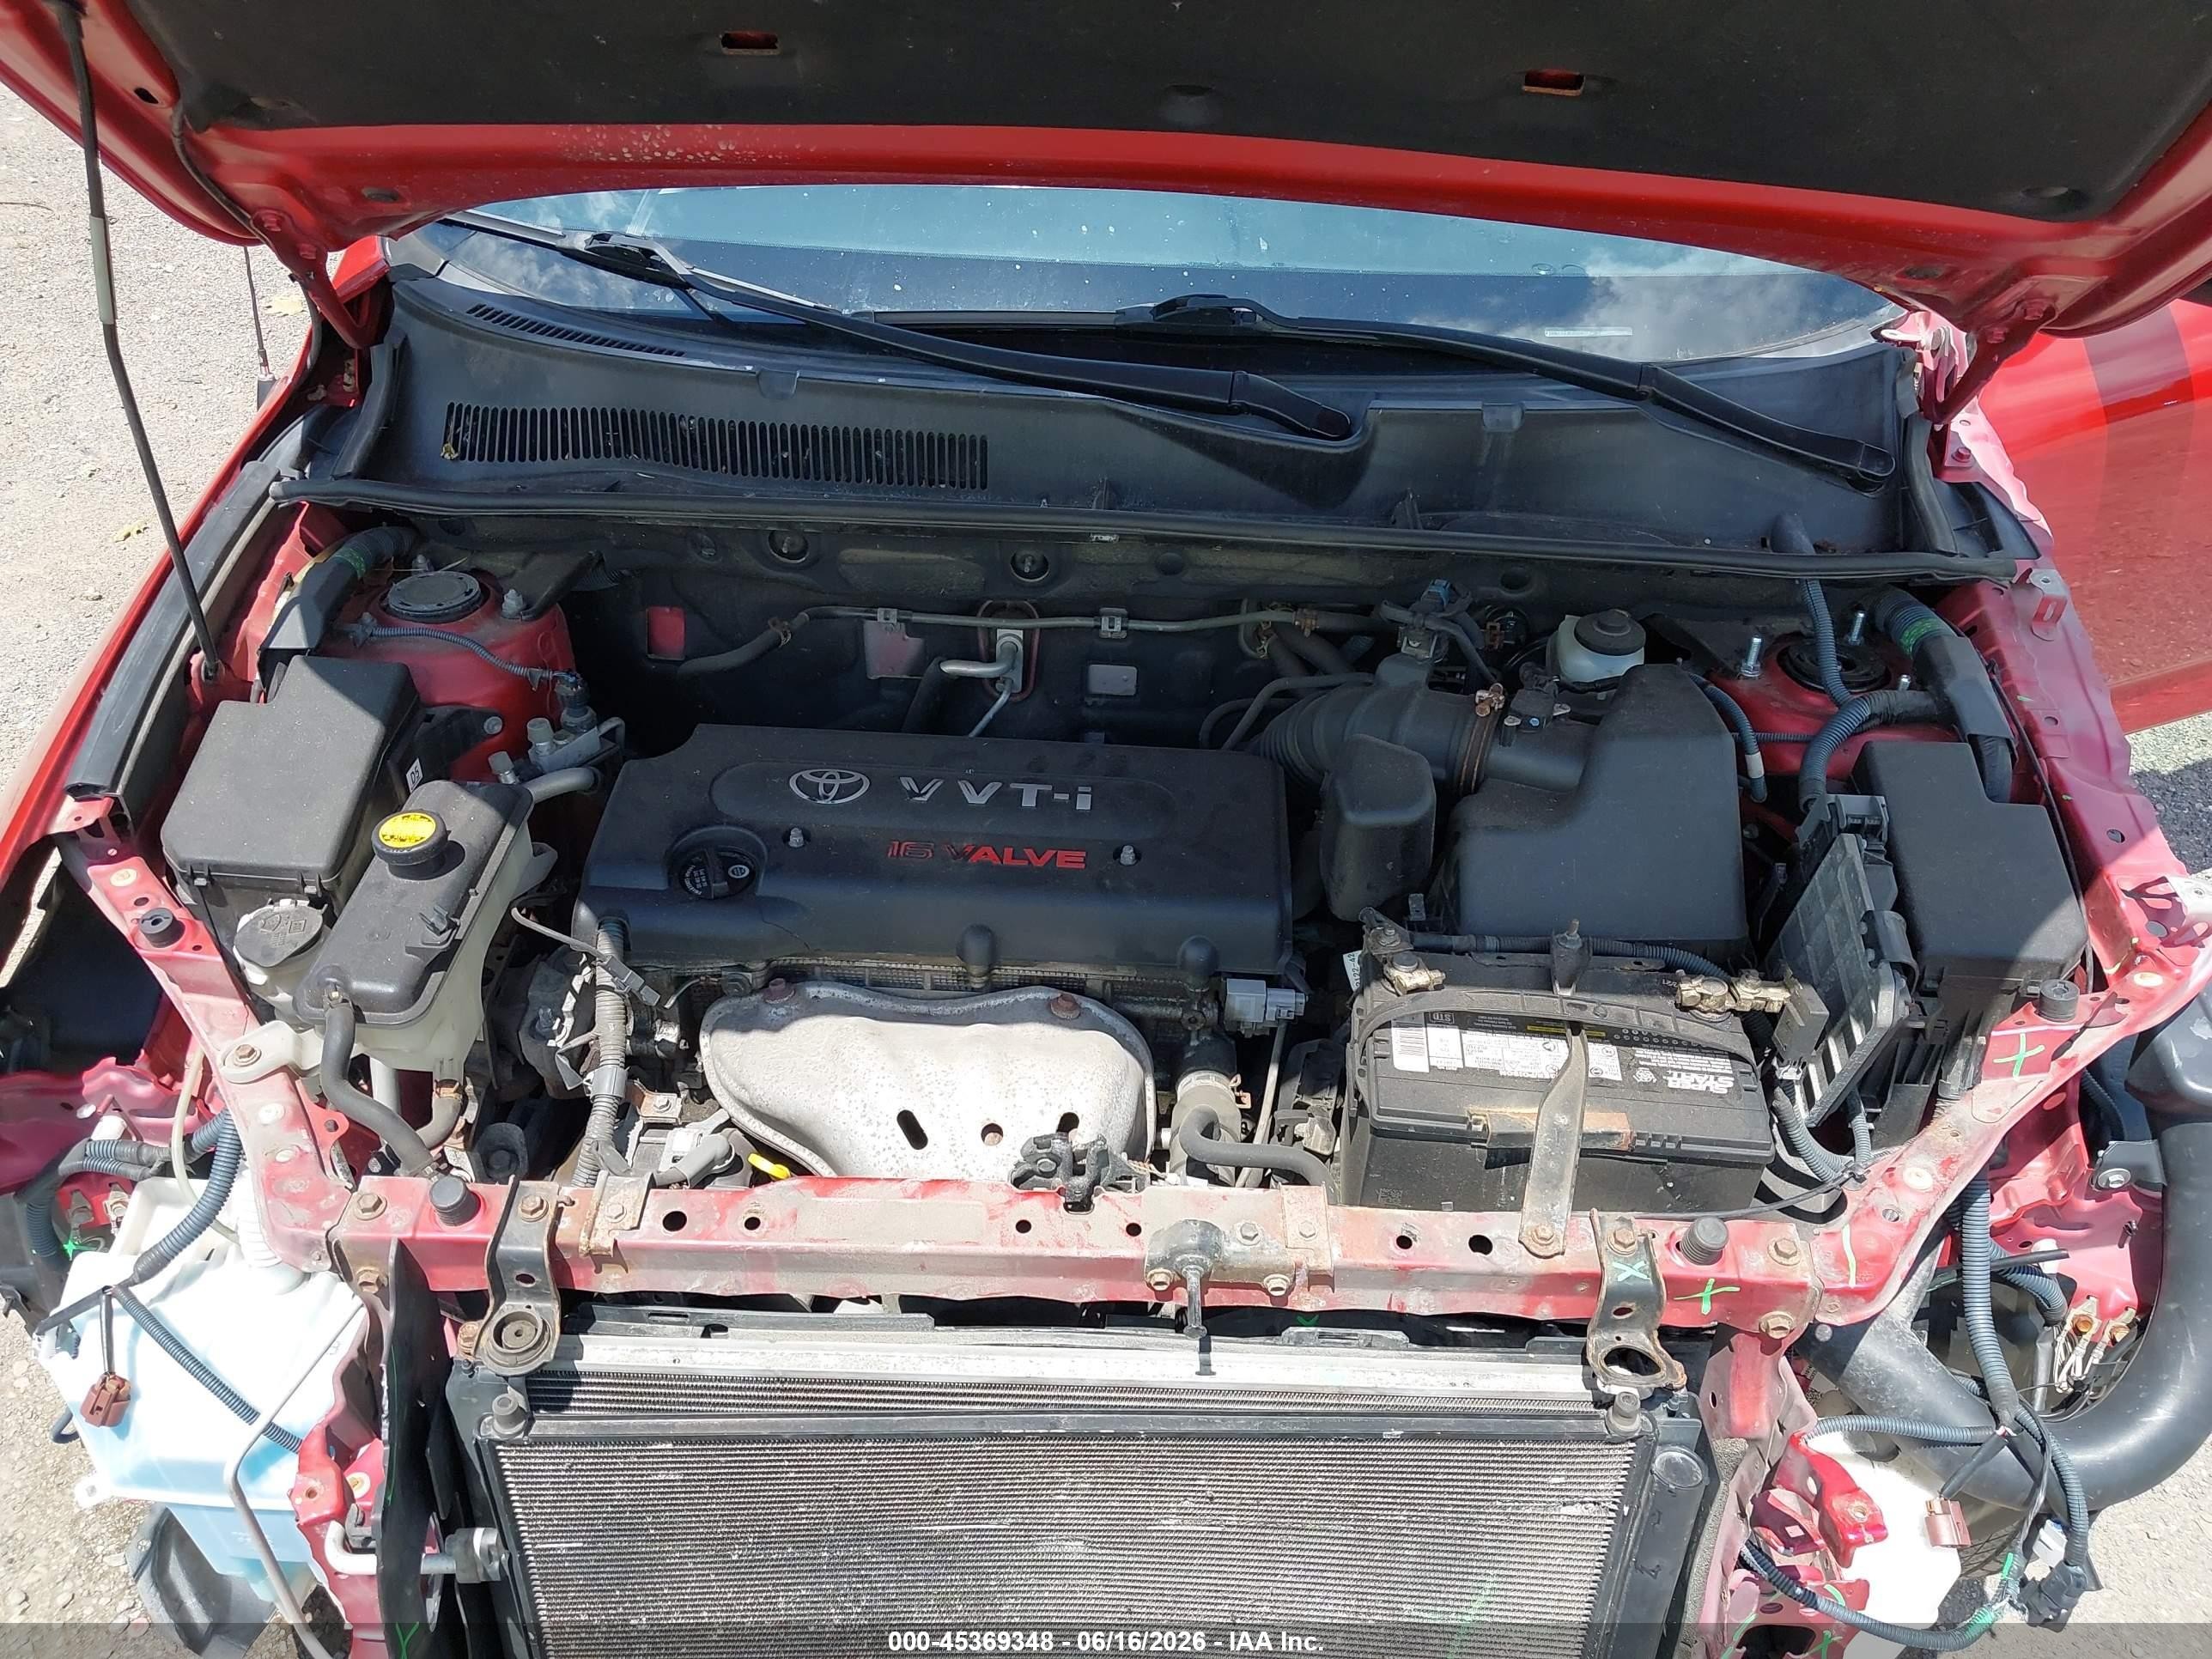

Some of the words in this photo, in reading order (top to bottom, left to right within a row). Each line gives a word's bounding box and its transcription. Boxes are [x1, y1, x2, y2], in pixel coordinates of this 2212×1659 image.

[887, 841, 934, 860] 16
[943, 843, 1086, 869] VALVE
[1433, 1012, 1451, 1022] STD
[1662, 1071, 1735, 1089] START
[1668, 1077, 1729, 1095] SUPER
